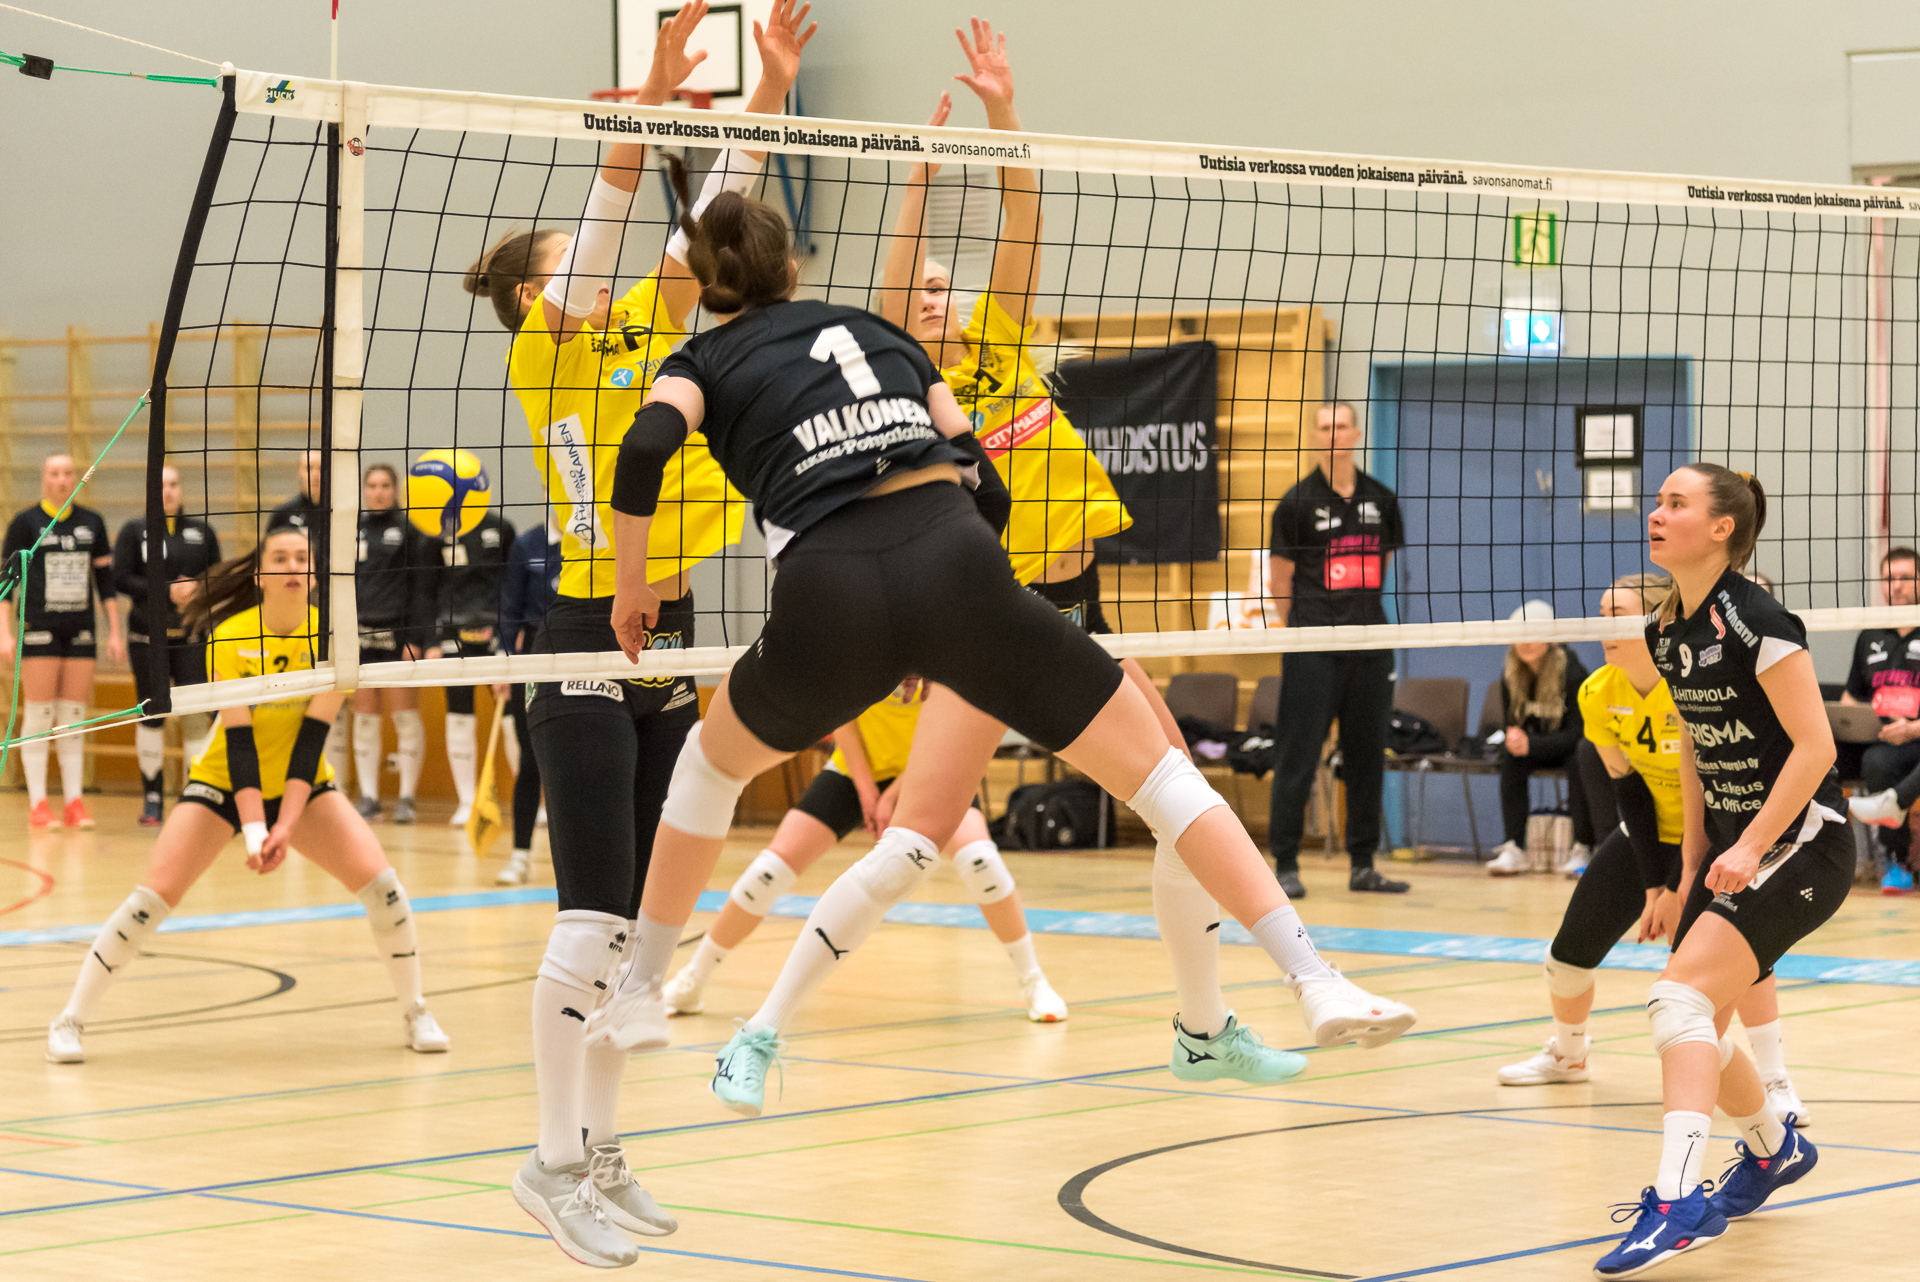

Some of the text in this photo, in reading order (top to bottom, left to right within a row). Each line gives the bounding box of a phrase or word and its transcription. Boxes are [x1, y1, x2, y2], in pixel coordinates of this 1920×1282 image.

[265, 89, 295, 100] HUCK
[583, 112, 1032, 160] Uutisia verkossa vuoden jokaisena päivänä. savonsanomat.fi
[1199, 154, 1553, 192] Uutisia verkossa vuoden jokaisena päivänä. savonsanomat.fi
[1688, 185, 1725, 200] Uutisia
[1727, 190, 1774, 203] verkossa
[1776, 193, 1812, 205] vuoden
[1814, 193, 1862, 208] jokaisena
[1863, 195, 1905, 211] päivänä.
[809, 325, 882, 400] 1
[792, 397, 932, 453] VALKONEN
[1074, 420, 1209, 475] UHDISTUS
[1678, 643, 1693, 678] 9
[566, 680, 620, 698] RELLANO
[1636, 715, 1657, 754] 4
[1687, 718, 1756, 748] RISMA
[1712, 779, 1765, 796] Lakeus
[1722, 796, 1762, 813] Office
